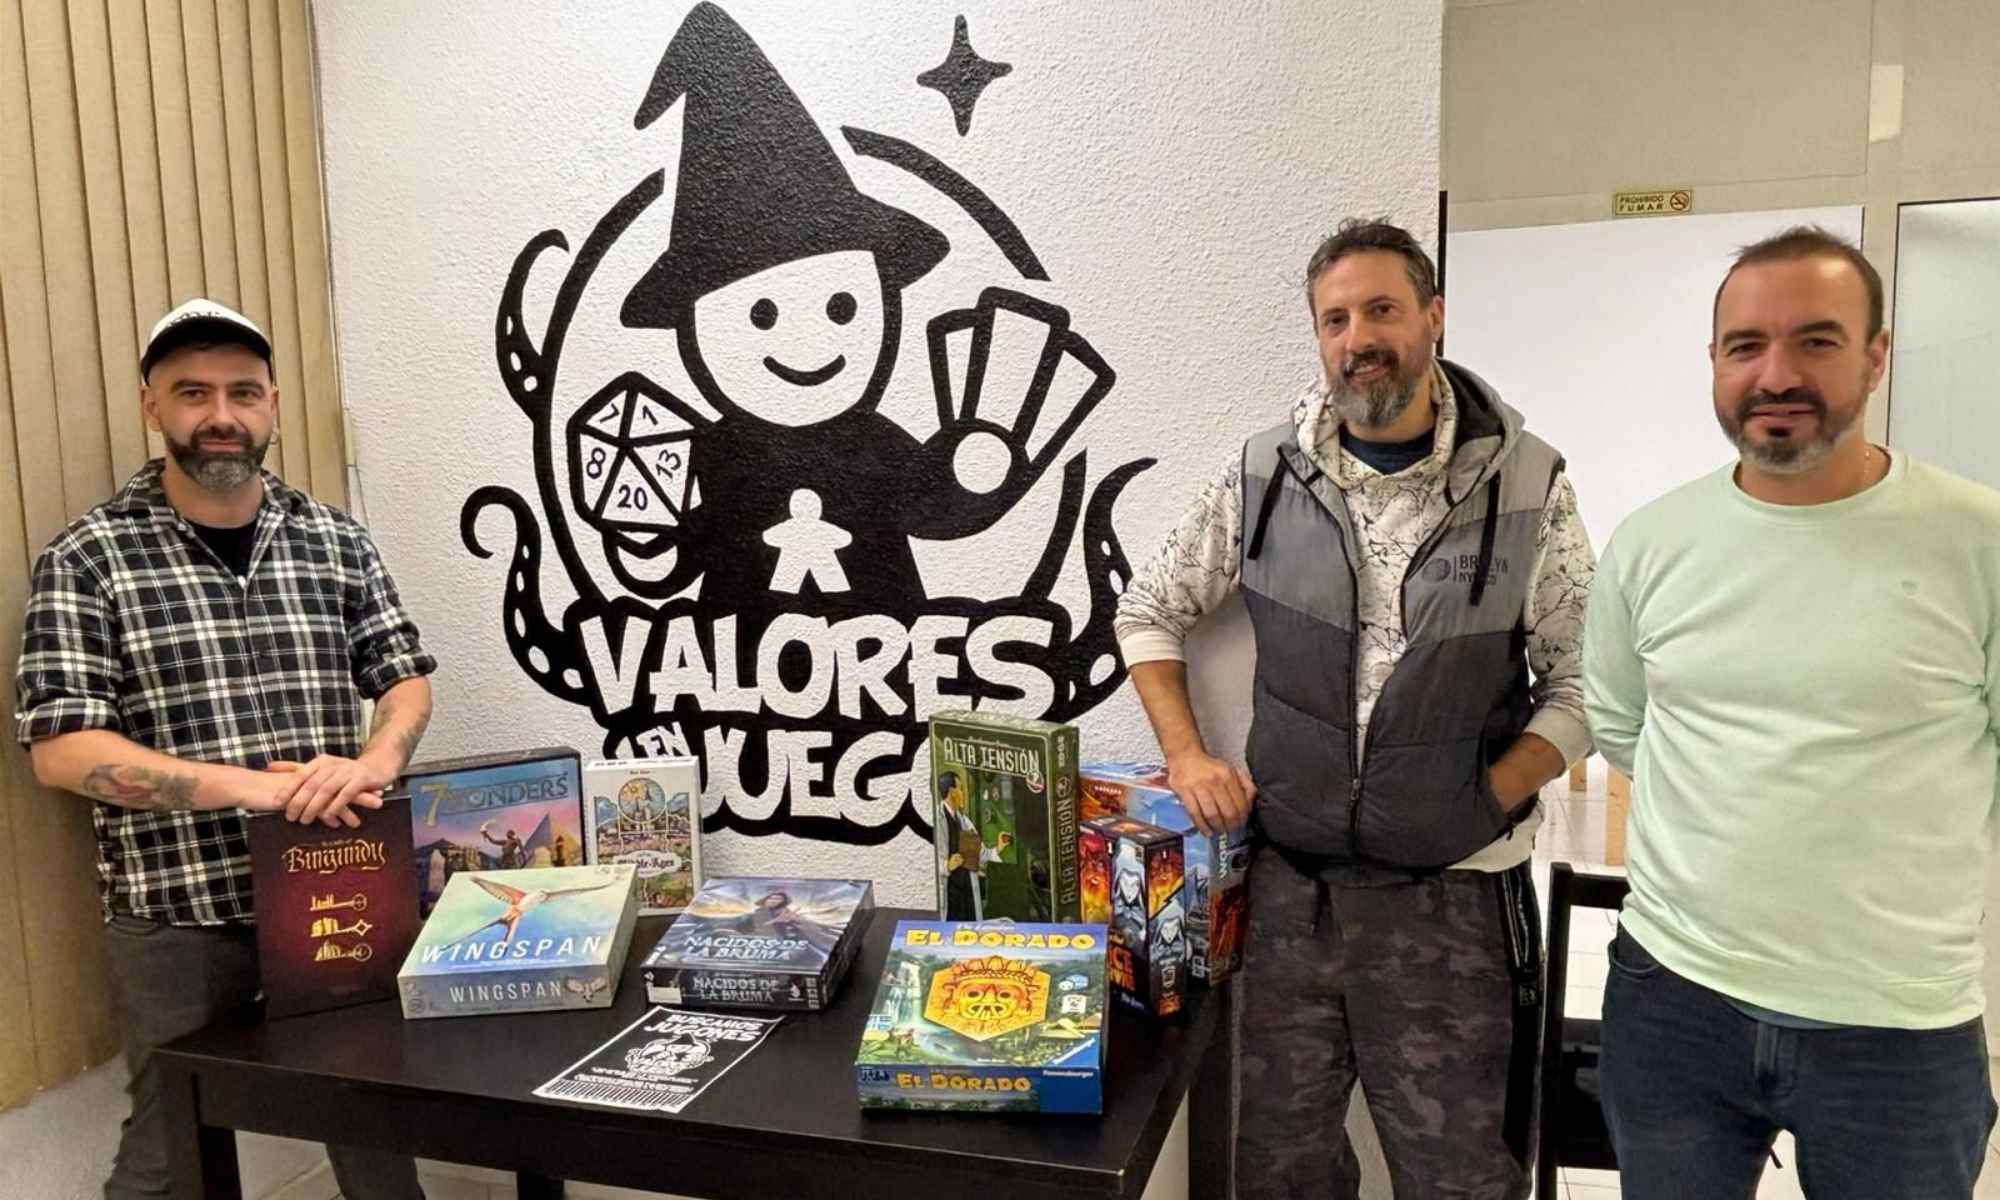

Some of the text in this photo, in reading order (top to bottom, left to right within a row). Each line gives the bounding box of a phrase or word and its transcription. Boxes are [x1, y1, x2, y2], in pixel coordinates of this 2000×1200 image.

[1620, 203, 1663, 211] FUMAR
[600, 403, 620, 423] 7
[642, 405, 659, 426] 1
[586, 447, 606, 479] 8
[655, 449, 682, 479] 13
[617, 484, 648, 511] 20
[579, 612, 1055, 721] VALORES
[636, 721, 691, 758] EN
[943, 736, 1040, 773] ALTA TENSIÓN
[420, 776, 568, 827] 7 ONDERS
[1060, 866, 1076, 905] ALTA
[421, 936, 601, 964] WINGSPAN
[684, 936, 778, 950] NACIDOS
[905, 929, 1096, 949] EL DORADO
[716, 947, 792, 961] BRUMA
[450, 980, 562, 1003] WINGSPAN
[693, 976, 780, 990] NACIDOS DE
[721, 989, 775, 1002] BRUMA
[643, 1021, 764, 1042] JUGONES
[895, 1071, 926, 1089] EL
[930, 1072, 1032, 1093] DORADO
